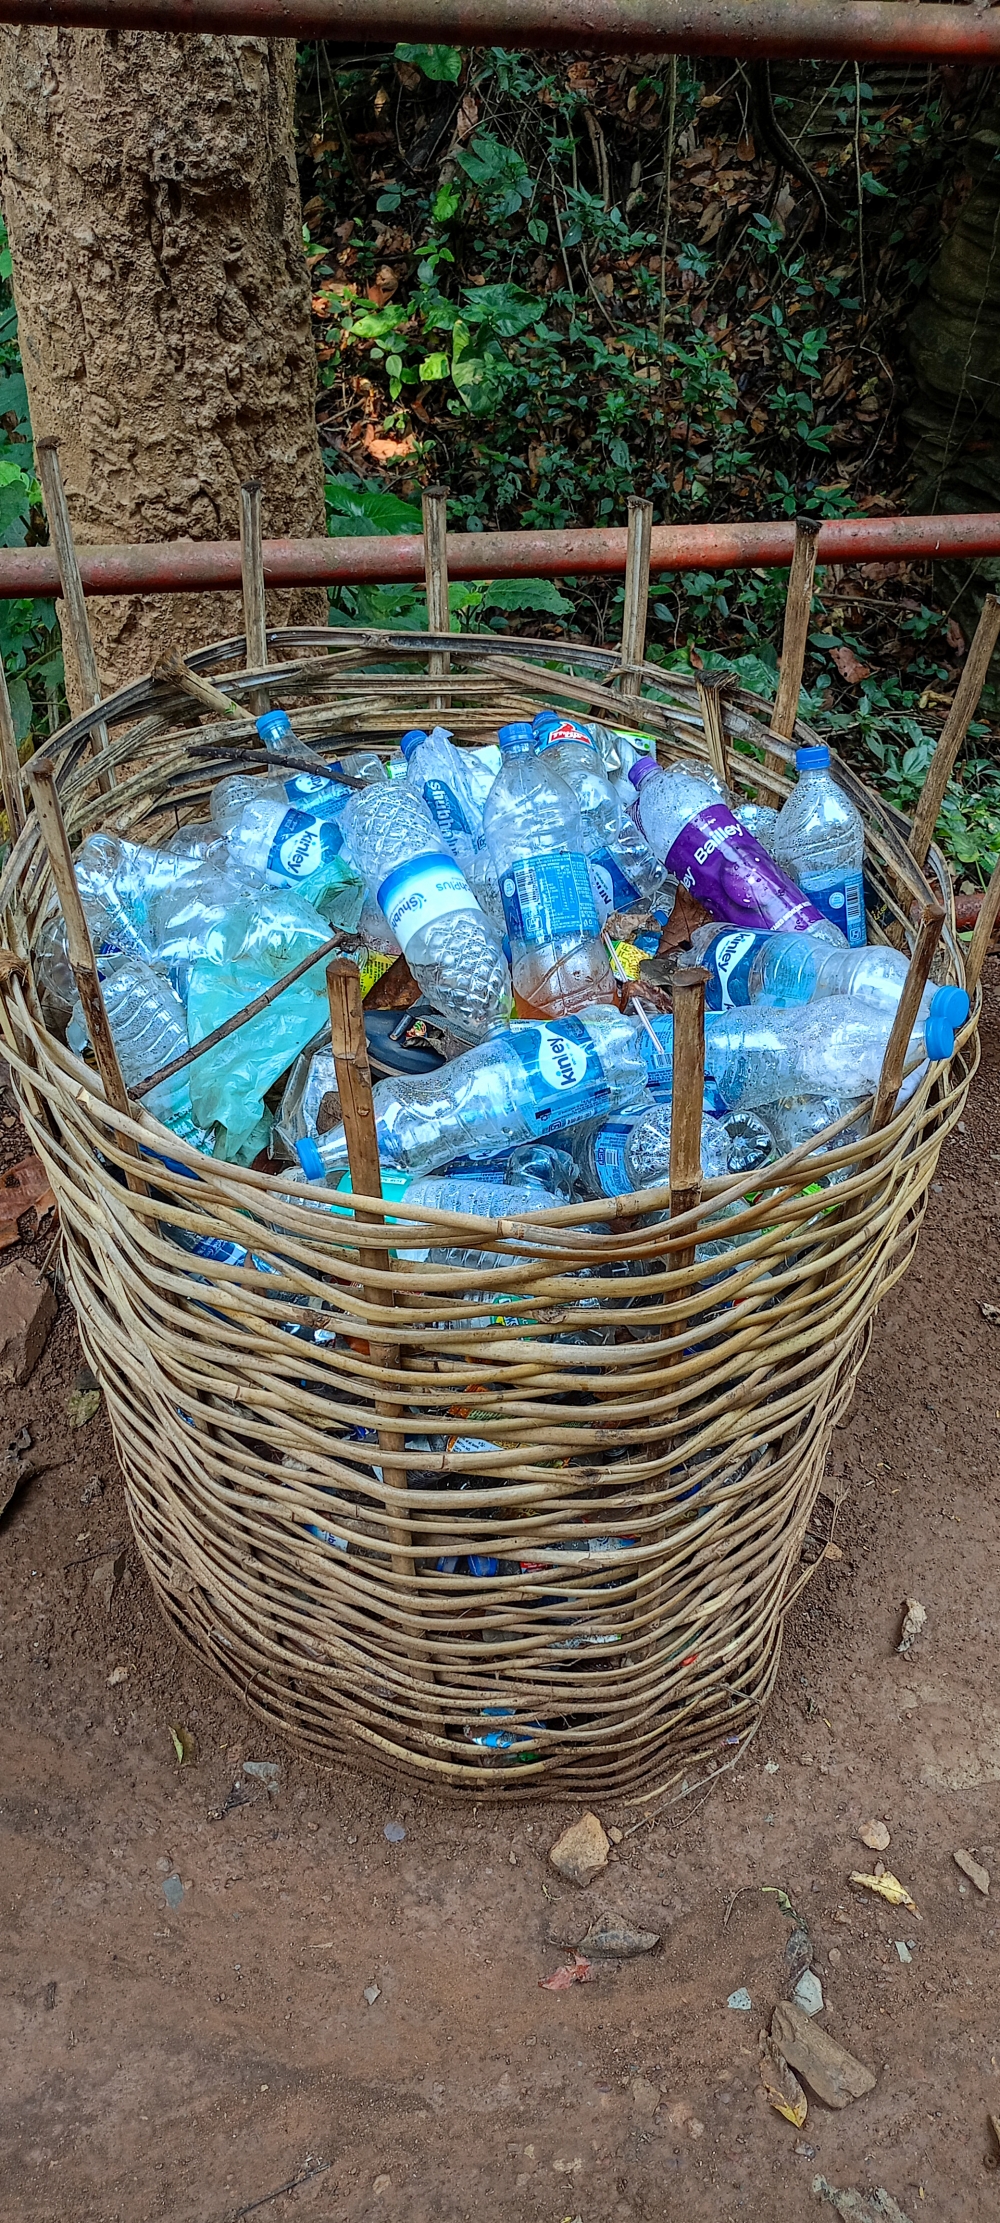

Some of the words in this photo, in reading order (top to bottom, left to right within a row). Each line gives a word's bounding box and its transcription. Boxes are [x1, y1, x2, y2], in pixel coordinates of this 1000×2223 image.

[287, 830, 319, 874] kinley
[693, 823, 744, 866] Bailley
[717, 933, 751, 973] kinley
[546, 1037, 577, 1086] kinley
